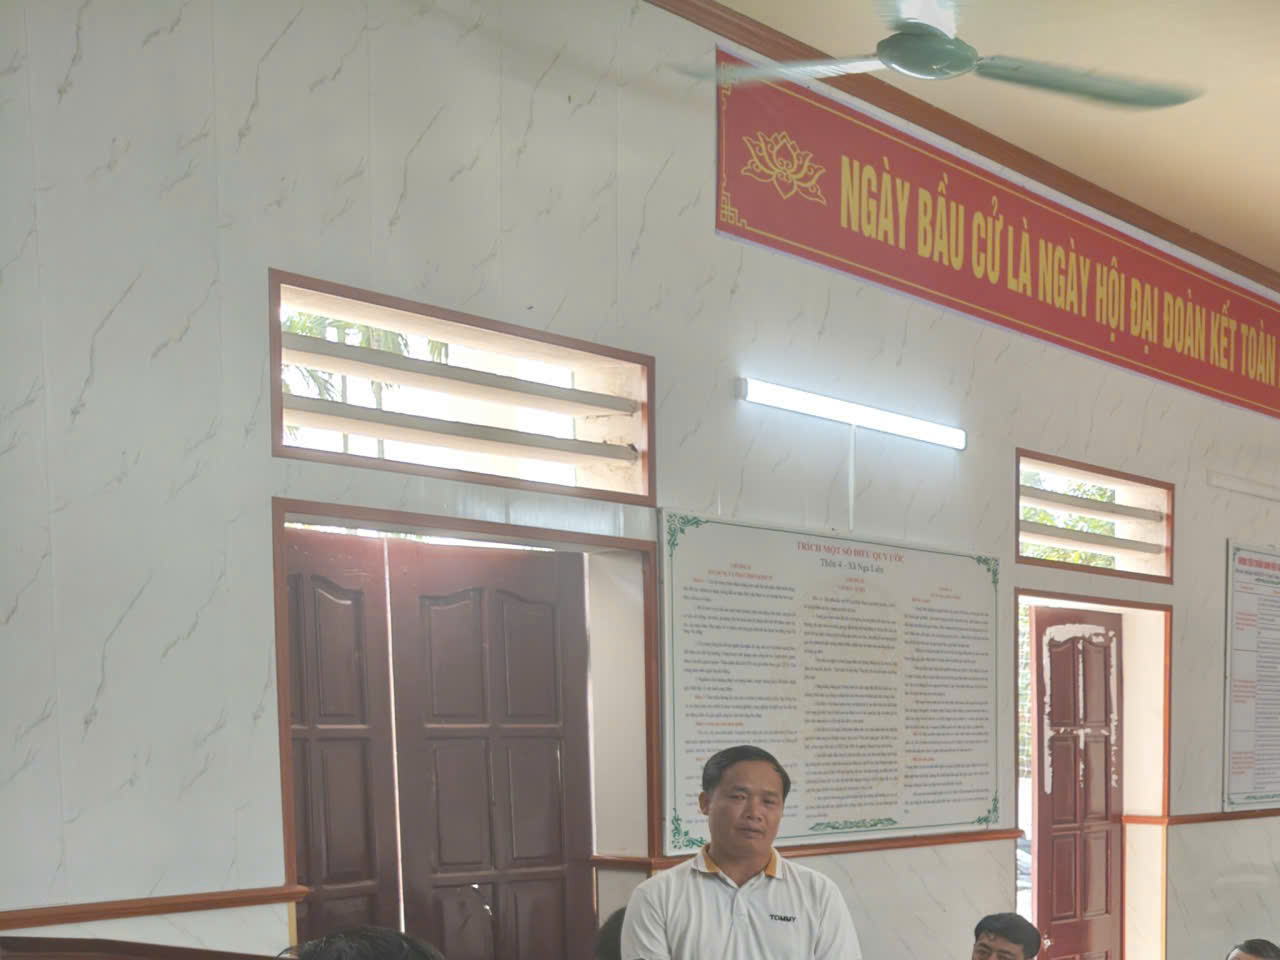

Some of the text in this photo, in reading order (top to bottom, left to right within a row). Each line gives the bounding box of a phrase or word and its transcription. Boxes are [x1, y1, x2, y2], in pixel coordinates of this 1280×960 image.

[840, 155, 910, 250] NGÀY
[917, 172, 965, 271] BẦU
[971, 195, 1004, 285] CỬ
[1007, 216, 1033, 297] LÀ
[1038, 237, 1091, 318] NGÀY
[1095, 256, 1126, 343] HỘI
[1130, 277, 1159, 355] ĐẠI
[1163, 288, 1206, 362] ĐOÀN
[1210, 300, 1237, 374] KẾT
[1240, 320, 1276, 387] TOÀN
